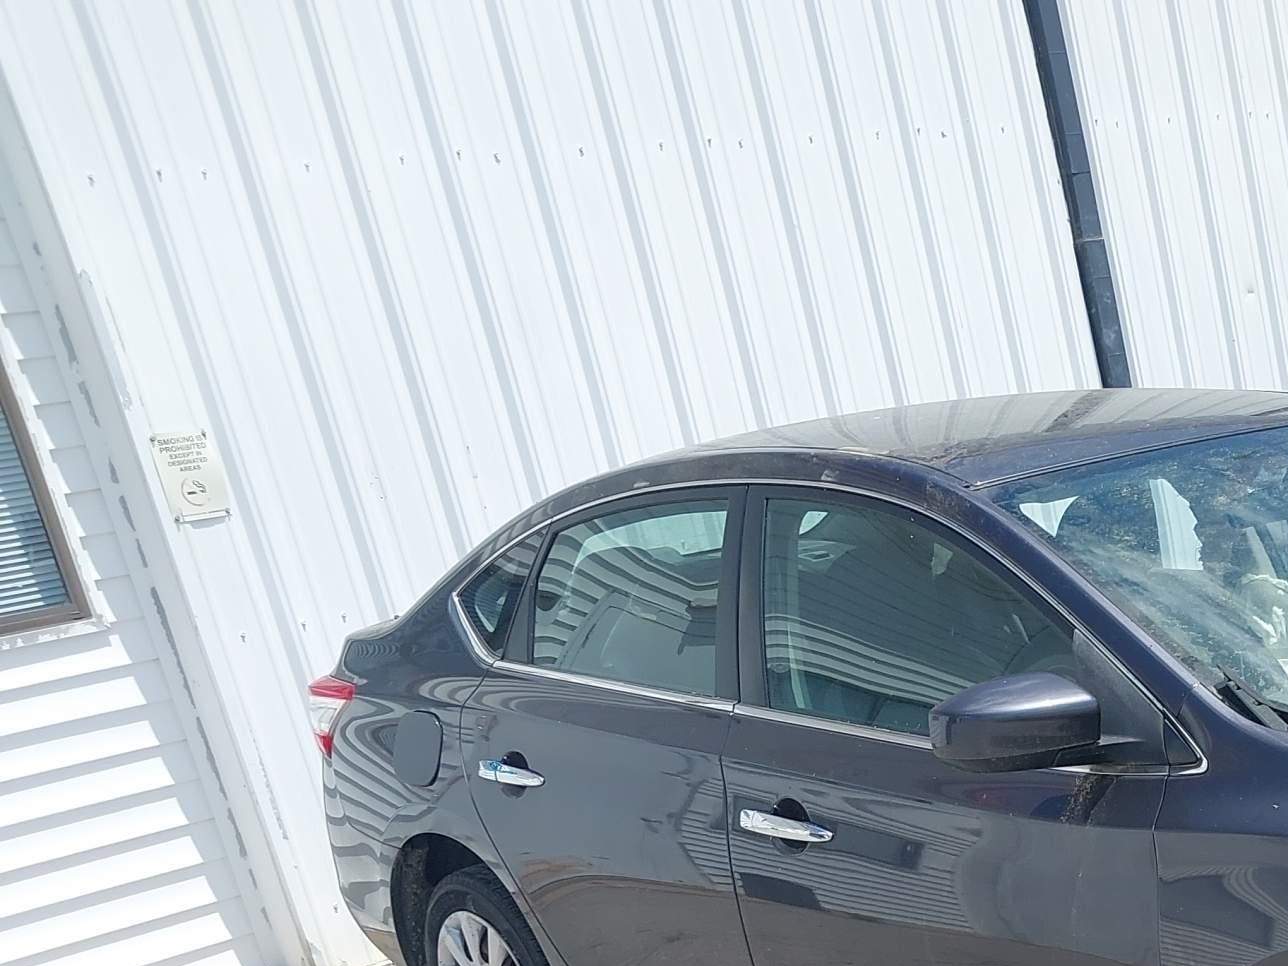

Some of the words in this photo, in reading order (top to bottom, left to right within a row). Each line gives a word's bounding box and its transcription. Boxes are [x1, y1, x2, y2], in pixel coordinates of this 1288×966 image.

[157, 435, 194, 446] SMOKING
[159, 441, 207, 454] PROHIBITED
[169, 451, 194, 460] EXCEPT
[167, 456, 208, 467] DESIGNATED
